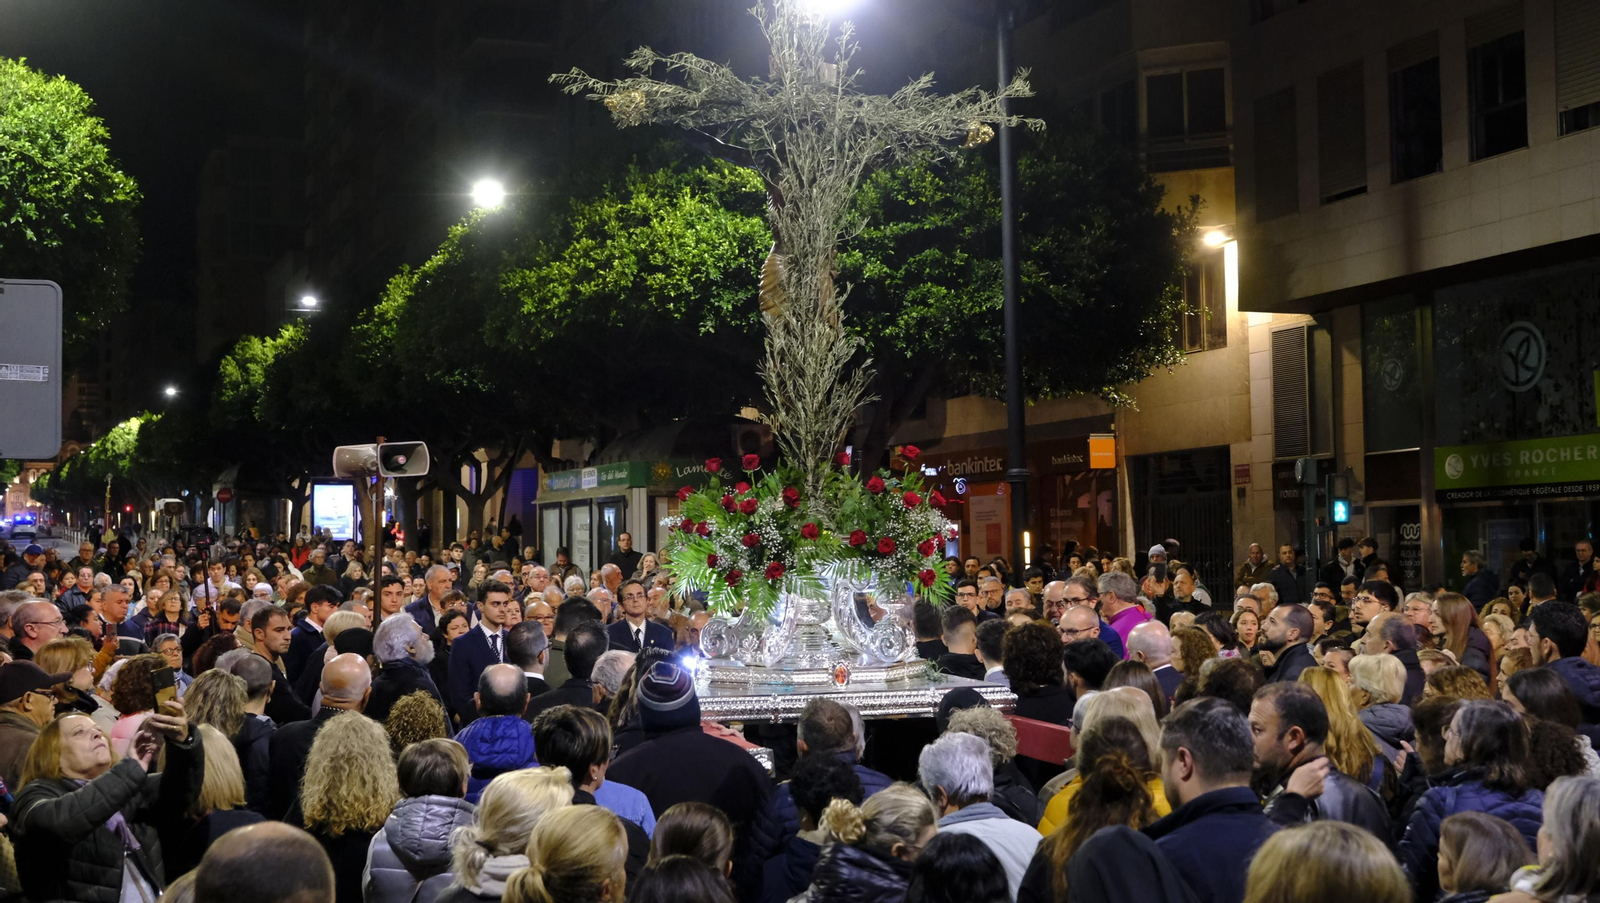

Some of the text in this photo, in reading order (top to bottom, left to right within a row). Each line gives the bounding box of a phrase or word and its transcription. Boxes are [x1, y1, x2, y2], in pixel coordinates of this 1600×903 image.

[1051, 454, 1083, 465] bankinter
[1470, 444, 1598, 468] YVES ROCHER
[947, 456, 1003, 476] bankinter
[1506, 467, 1557, 478] FRANCE
[1446, 490, 1474, 500] CREADOR
[1475, 490, 1483, 498] DE
[1532, 485, 1562, 495] VÉGÉTALE
[1563, 485, 1583, 493] DESDE
[1585, 484, 1600, 492] 1959
